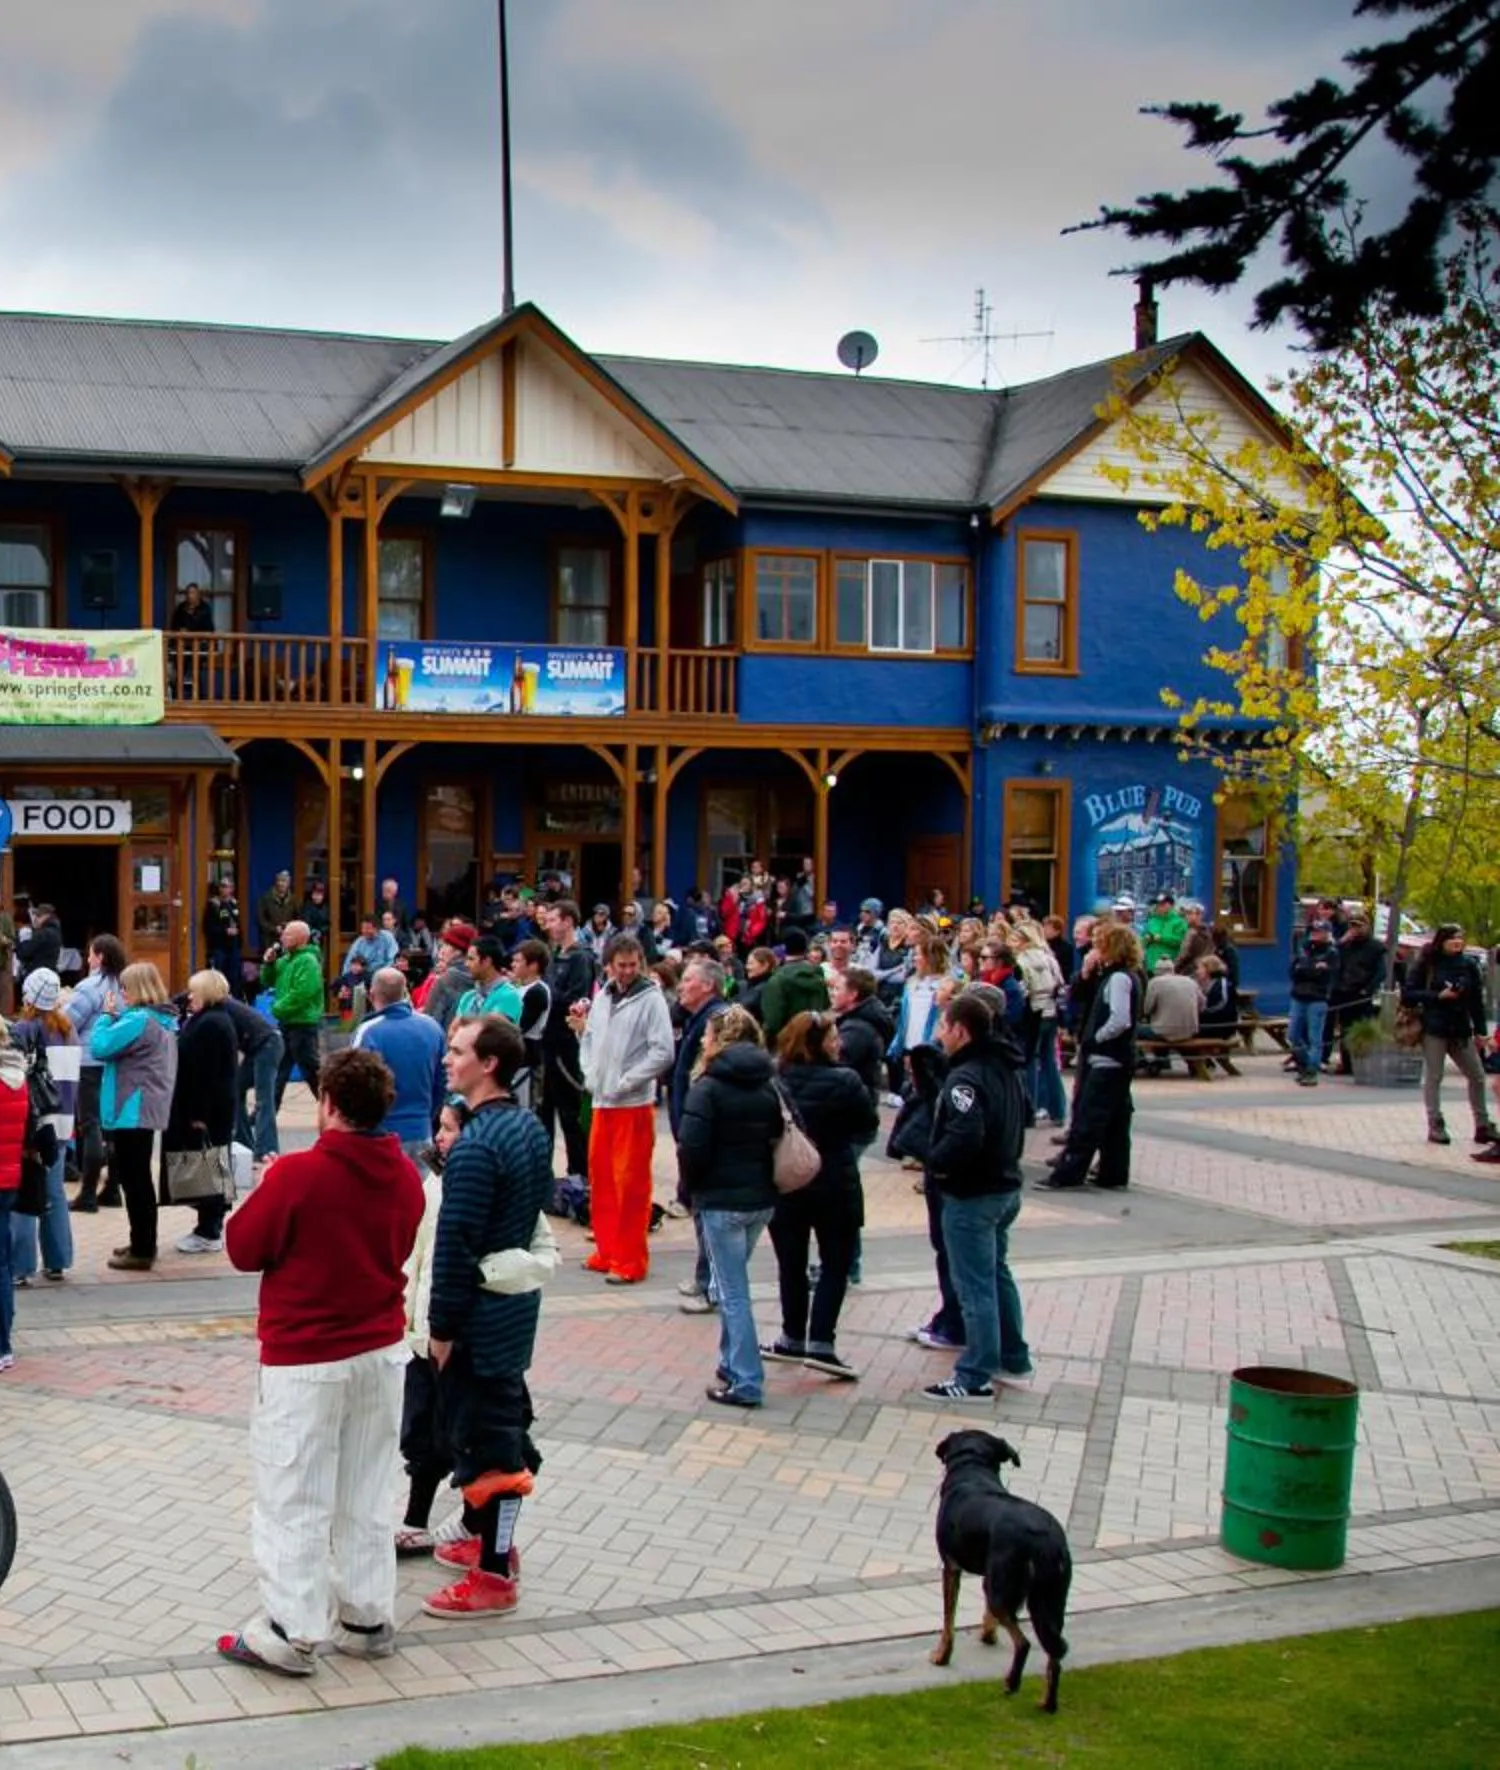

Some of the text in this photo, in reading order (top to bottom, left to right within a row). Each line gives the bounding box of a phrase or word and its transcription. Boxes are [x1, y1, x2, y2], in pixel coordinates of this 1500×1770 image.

[421, 655, 493, 677] SUMMIT
[547, 660, 614, 680] SUMMIT
[1083, 785, 1201, 827] BLUE PUB
[23, 806, 115, 830] FOOD
